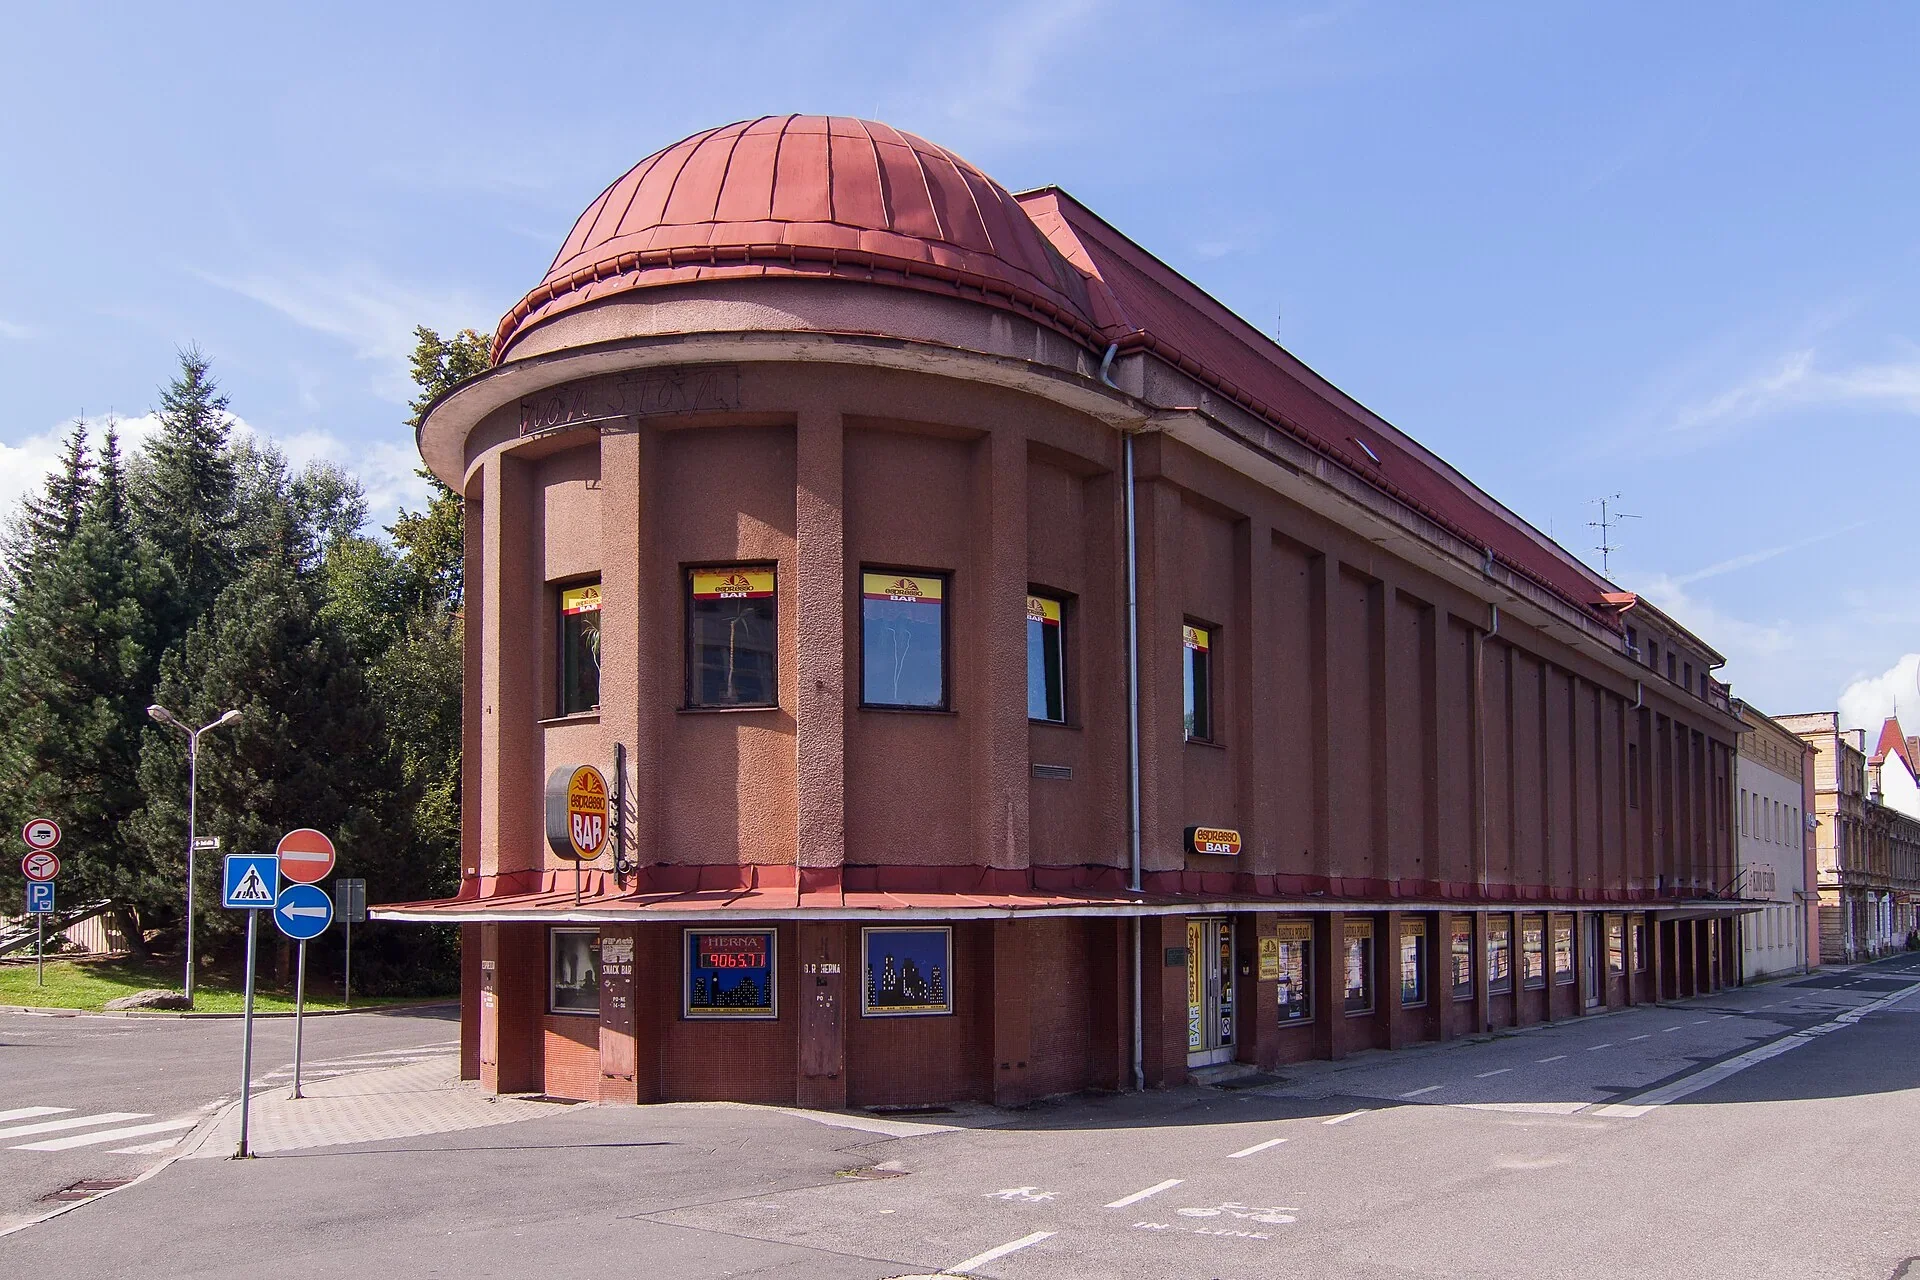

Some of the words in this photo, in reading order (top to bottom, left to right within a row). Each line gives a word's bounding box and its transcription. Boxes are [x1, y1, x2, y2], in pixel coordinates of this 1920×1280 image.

[571, 794, 605, 810] espresso
[573, 813, 602, 850] BAR
[1197, 830, 1238, 842] espresso
[1205, 842, 1231, 852] BAR
[33, 885, 49, 903] P
[708, 937, 757, 947] HERNA
[602, 965, 619, 975] SNACK
[621, 965, 632, 975] BAR
[1189, 1005, 1199, 1046] BAR
